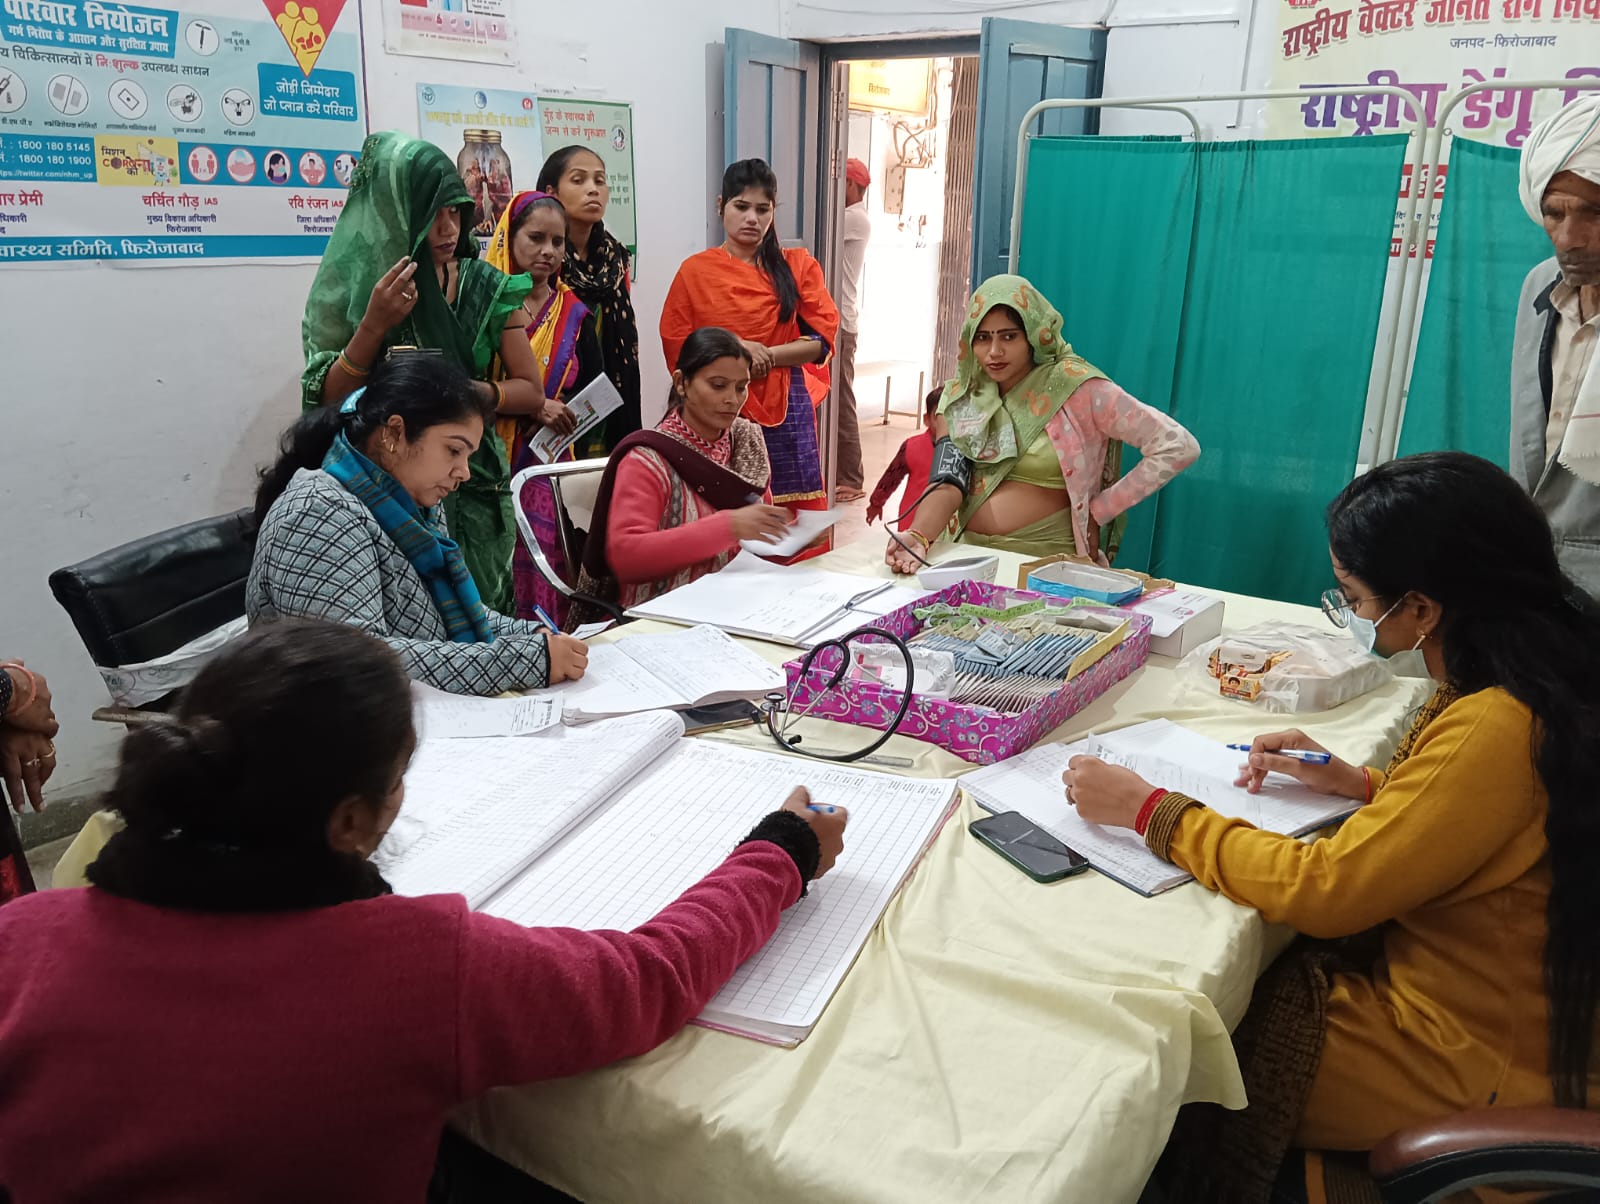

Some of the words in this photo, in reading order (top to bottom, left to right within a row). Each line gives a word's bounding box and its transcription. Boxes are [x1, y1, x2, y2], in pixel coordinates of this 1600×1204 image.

[83, 1, 169, 37] नियोजन
[1283, 7, 1352, 57] राष्ट्रीय
[1358, 0, 1417, 33] वेक्टर
[55, 29, 64, 42] के
[68, 32, 97, 46] आसान
[100, 34, 116, 47] और
[149, 41, 169, 53] उपाय
[12, 44, 81, 65] चिकित्सालयों
[85, 52, 93, 66] में
[142, 61, 178, 75] उपलब्ध
[181, 65, 209, 77] साधन
[276, 77, 298, 97] जोड़ी
[300, 80, 341, 98] जिम्मेदार
[263, 96, 278, 111] जो
[279, 101, 304, 113] प्लान
[322, 102, 354, 117] परिवार
[1300, 69, 1448, 136] राष्ट्रीय
[1462, 68, 1539, 146] डेंगू
[18, 140, 42, 150] 1800
[46, 141, 64, 151] 180
[66, 142, 90, 151] 5145
[19, 154, 43, 164] 1800
[47, 155, 65, 165] 180
[68, 156, 92, 165] 1900
[18, 190, 43, 207] प्रेमी
[142, 192, 174, 207] चर्चित
[178, 192, 200, 211] गौड़
[204, 197, 219, 206] IAS
[288, 195, 304, 209] रवि
[307, 195, 329, 210] रंजन
[331, 199, 344, 208] IAS
[164, 213, 186, 223] विकास
[188, 213, 217, 223] अधिकारी
[166, 224, 202, 234] फिरोजाबाद
[0, 244, 52, 258] वास्थ्य
[121, 238, 204, 256] फिरोजाबाद
